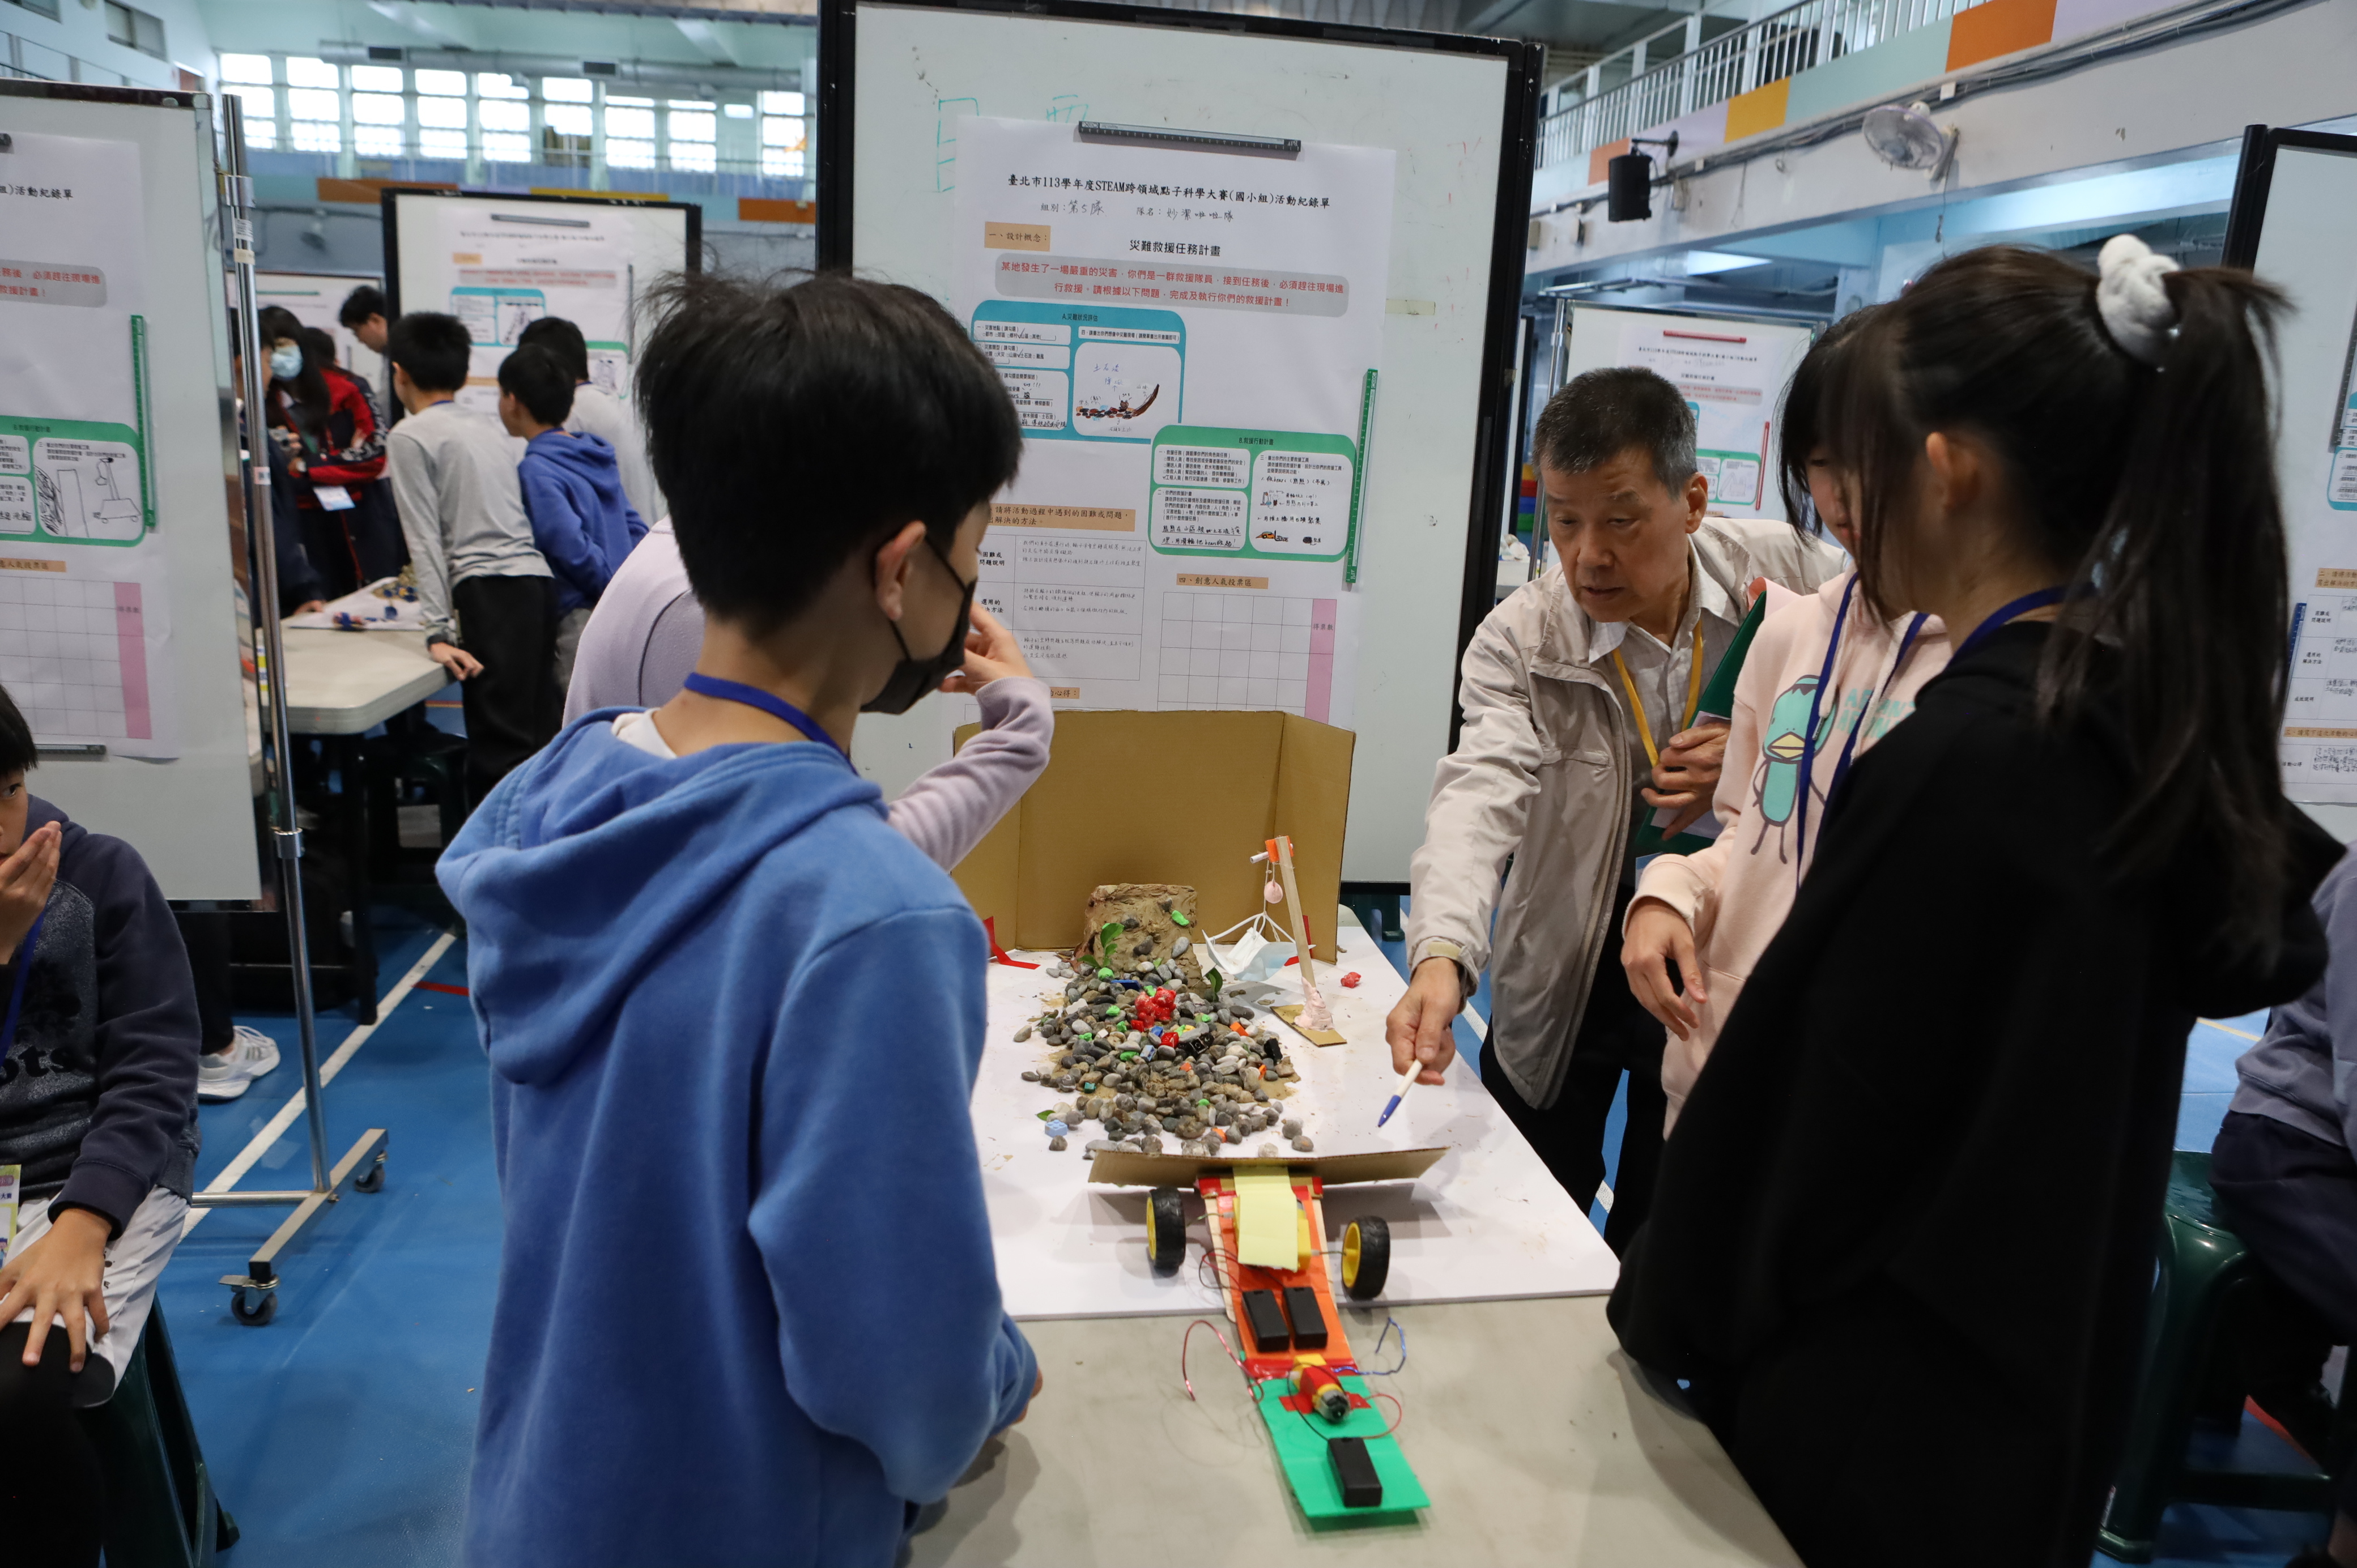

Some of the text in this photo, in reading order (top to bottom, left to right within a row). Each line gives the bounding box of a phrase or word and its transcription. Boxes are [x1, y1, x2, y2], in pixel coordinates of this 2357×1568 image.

[1008, 174, 1330, 208] 臺北市113學年度STEAM跨領域點子科學大賽(國小組)活動紀錄單
[988, 231, 1048, 242] 一、設計概念：
[1129, 239, 1220, 257] 災難救援任務計畫
[1178, 577, 1252, 587] 四、創意人氣投票區
